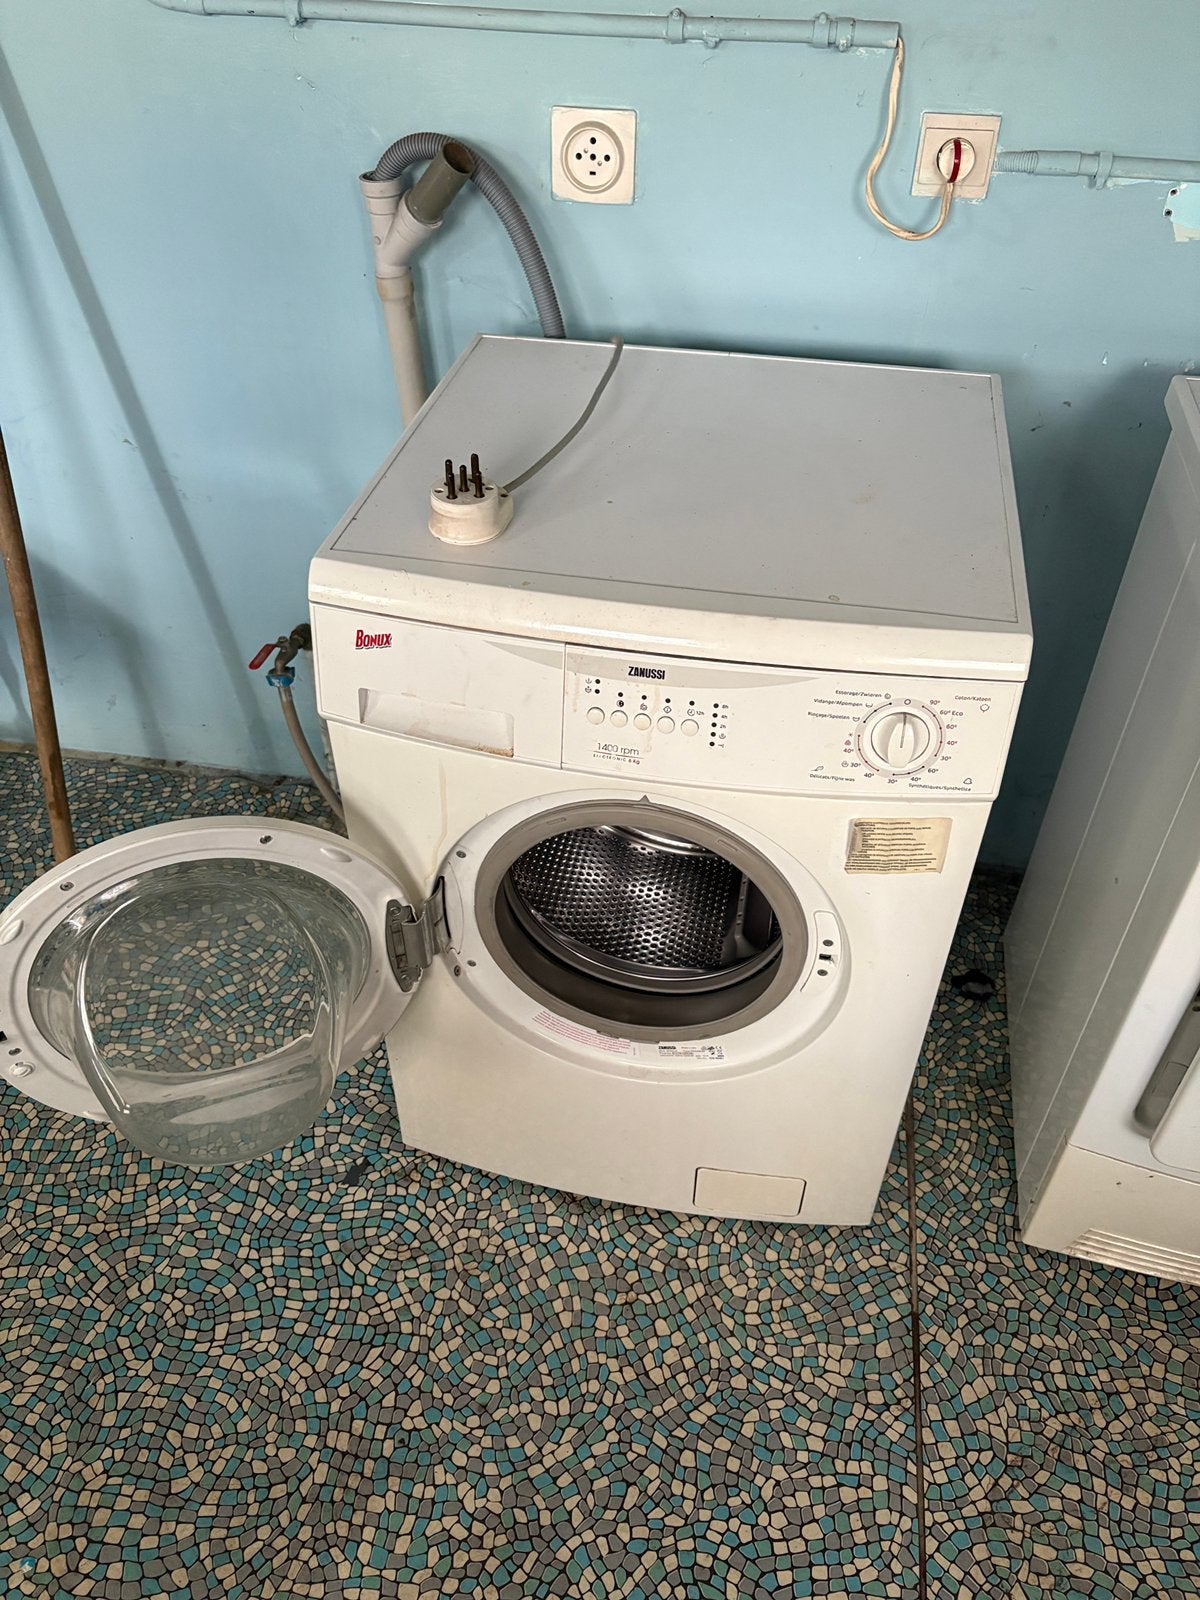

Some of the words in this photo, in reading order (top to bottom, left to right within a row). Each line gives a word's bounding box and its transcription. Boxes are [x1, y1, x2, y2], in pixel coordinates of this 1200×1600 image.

[628, 666, 666, 680] ZANUSSI
[597, 742, 619, 753] 1400
[620, 747, 640, 756] rpm
